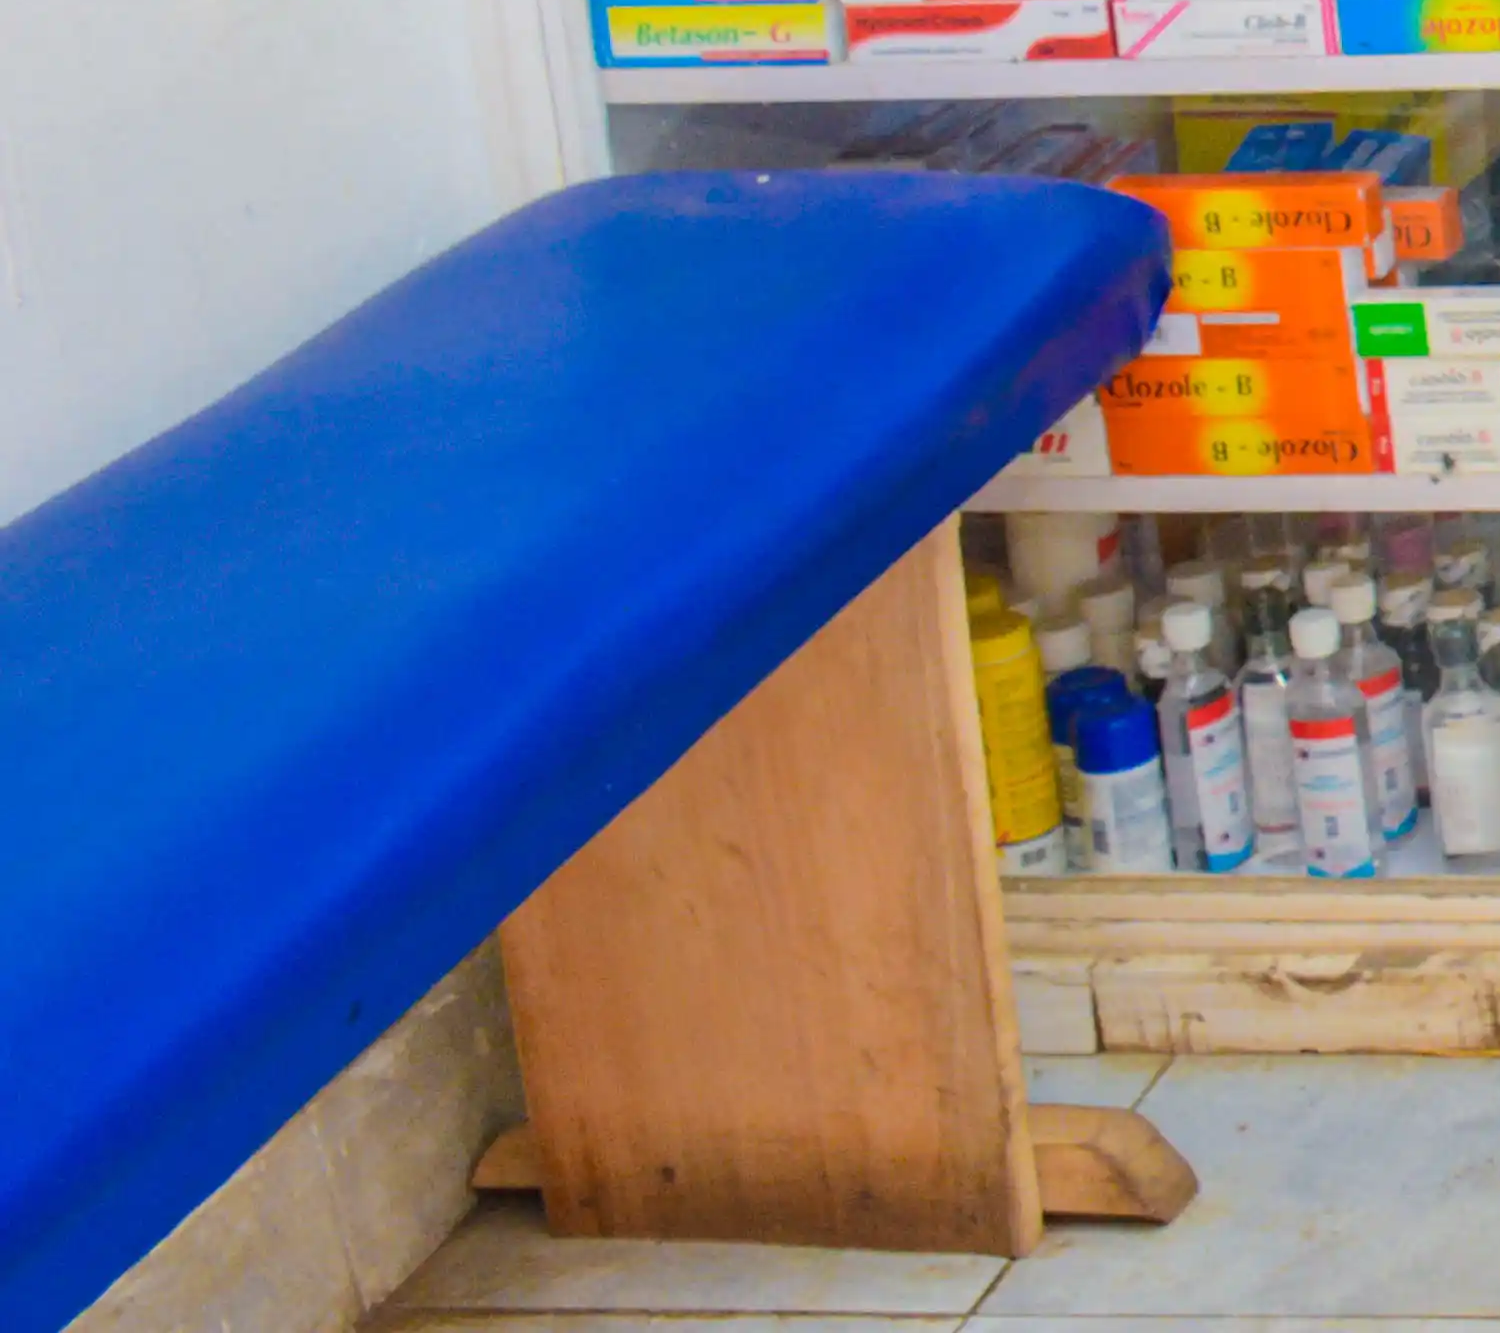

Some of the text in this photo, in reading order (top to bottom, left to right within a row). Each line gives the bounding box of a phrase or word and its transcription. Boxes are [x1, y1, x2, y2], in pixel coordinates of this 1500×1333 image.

[769, 19, 793, 45] G
[1204, 210, 1222, 234] B
[1250, 208, 1353, 236] Clozole
[1221, 266, 1238, 289] B
[1237, 373, 1254, 397] B
[1211, 439, 1230, 462] B
[1257, 437, 1360, 465] Clozole
